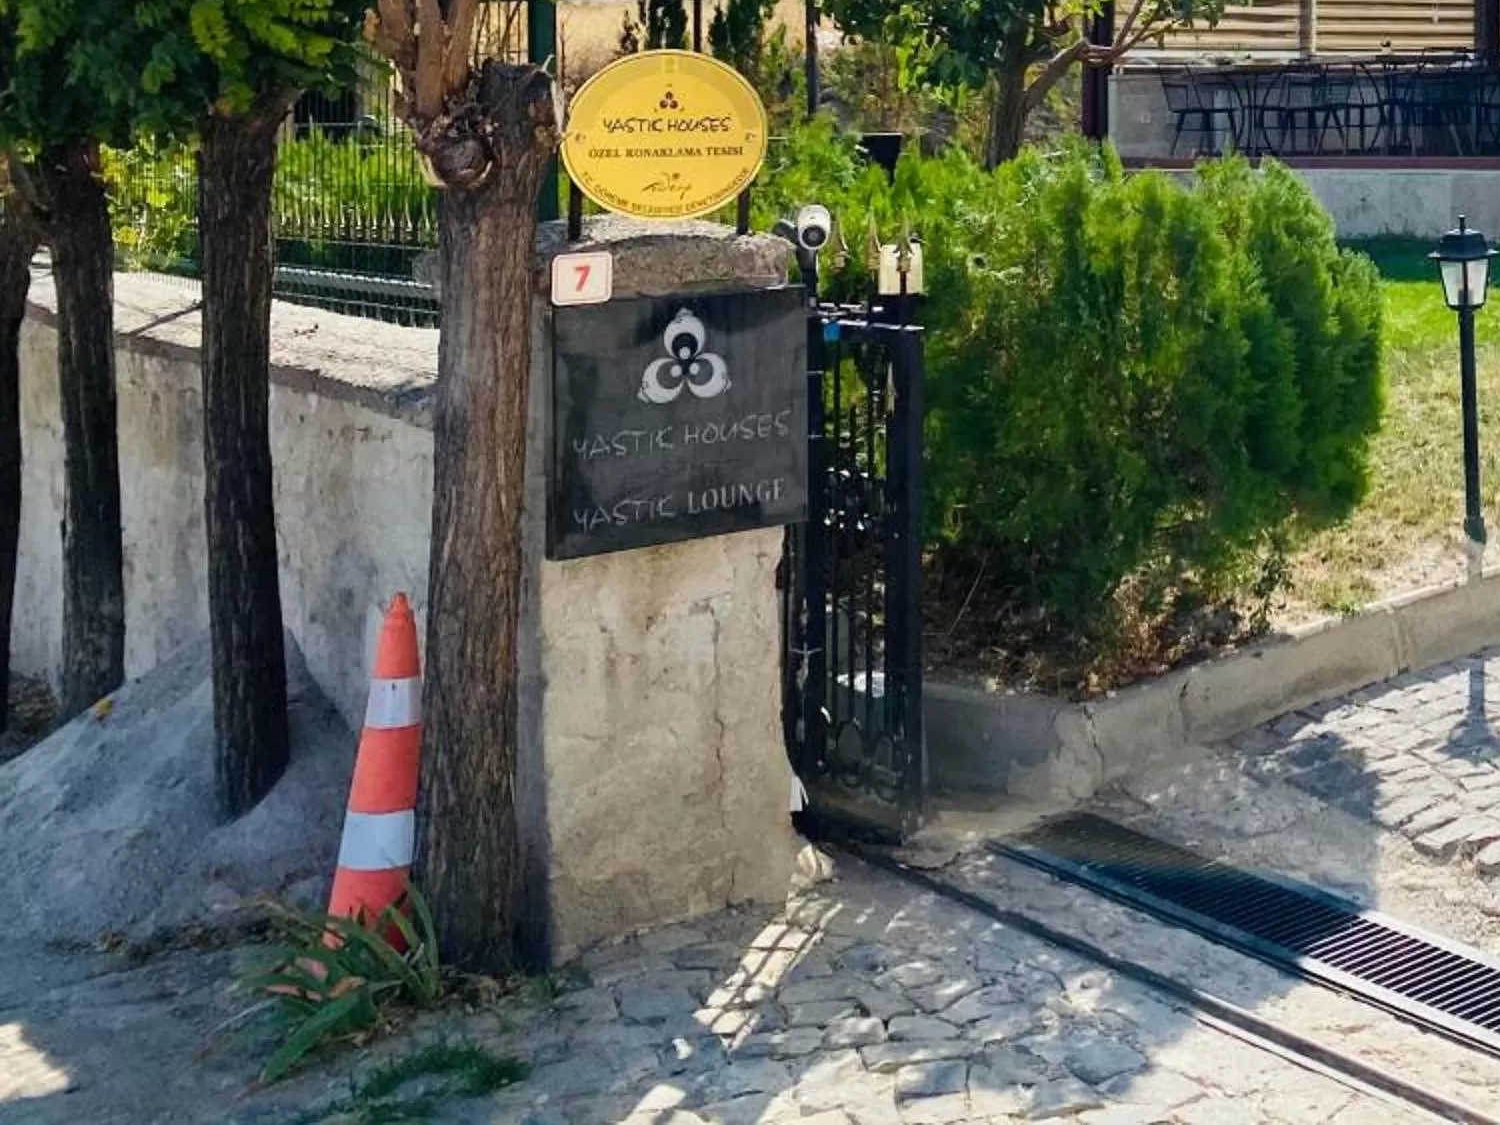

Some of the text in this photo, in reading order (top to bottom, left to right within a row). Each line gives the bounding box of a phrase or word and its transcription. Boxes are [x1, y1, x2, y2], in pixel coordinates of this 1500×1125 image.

[667, 115, 731, 132] HOUSES
[572, 265, 592, 292] 7
[684, 409, 792, 445] HOUSES
[687, 478, 786, 515] LOUNGE
